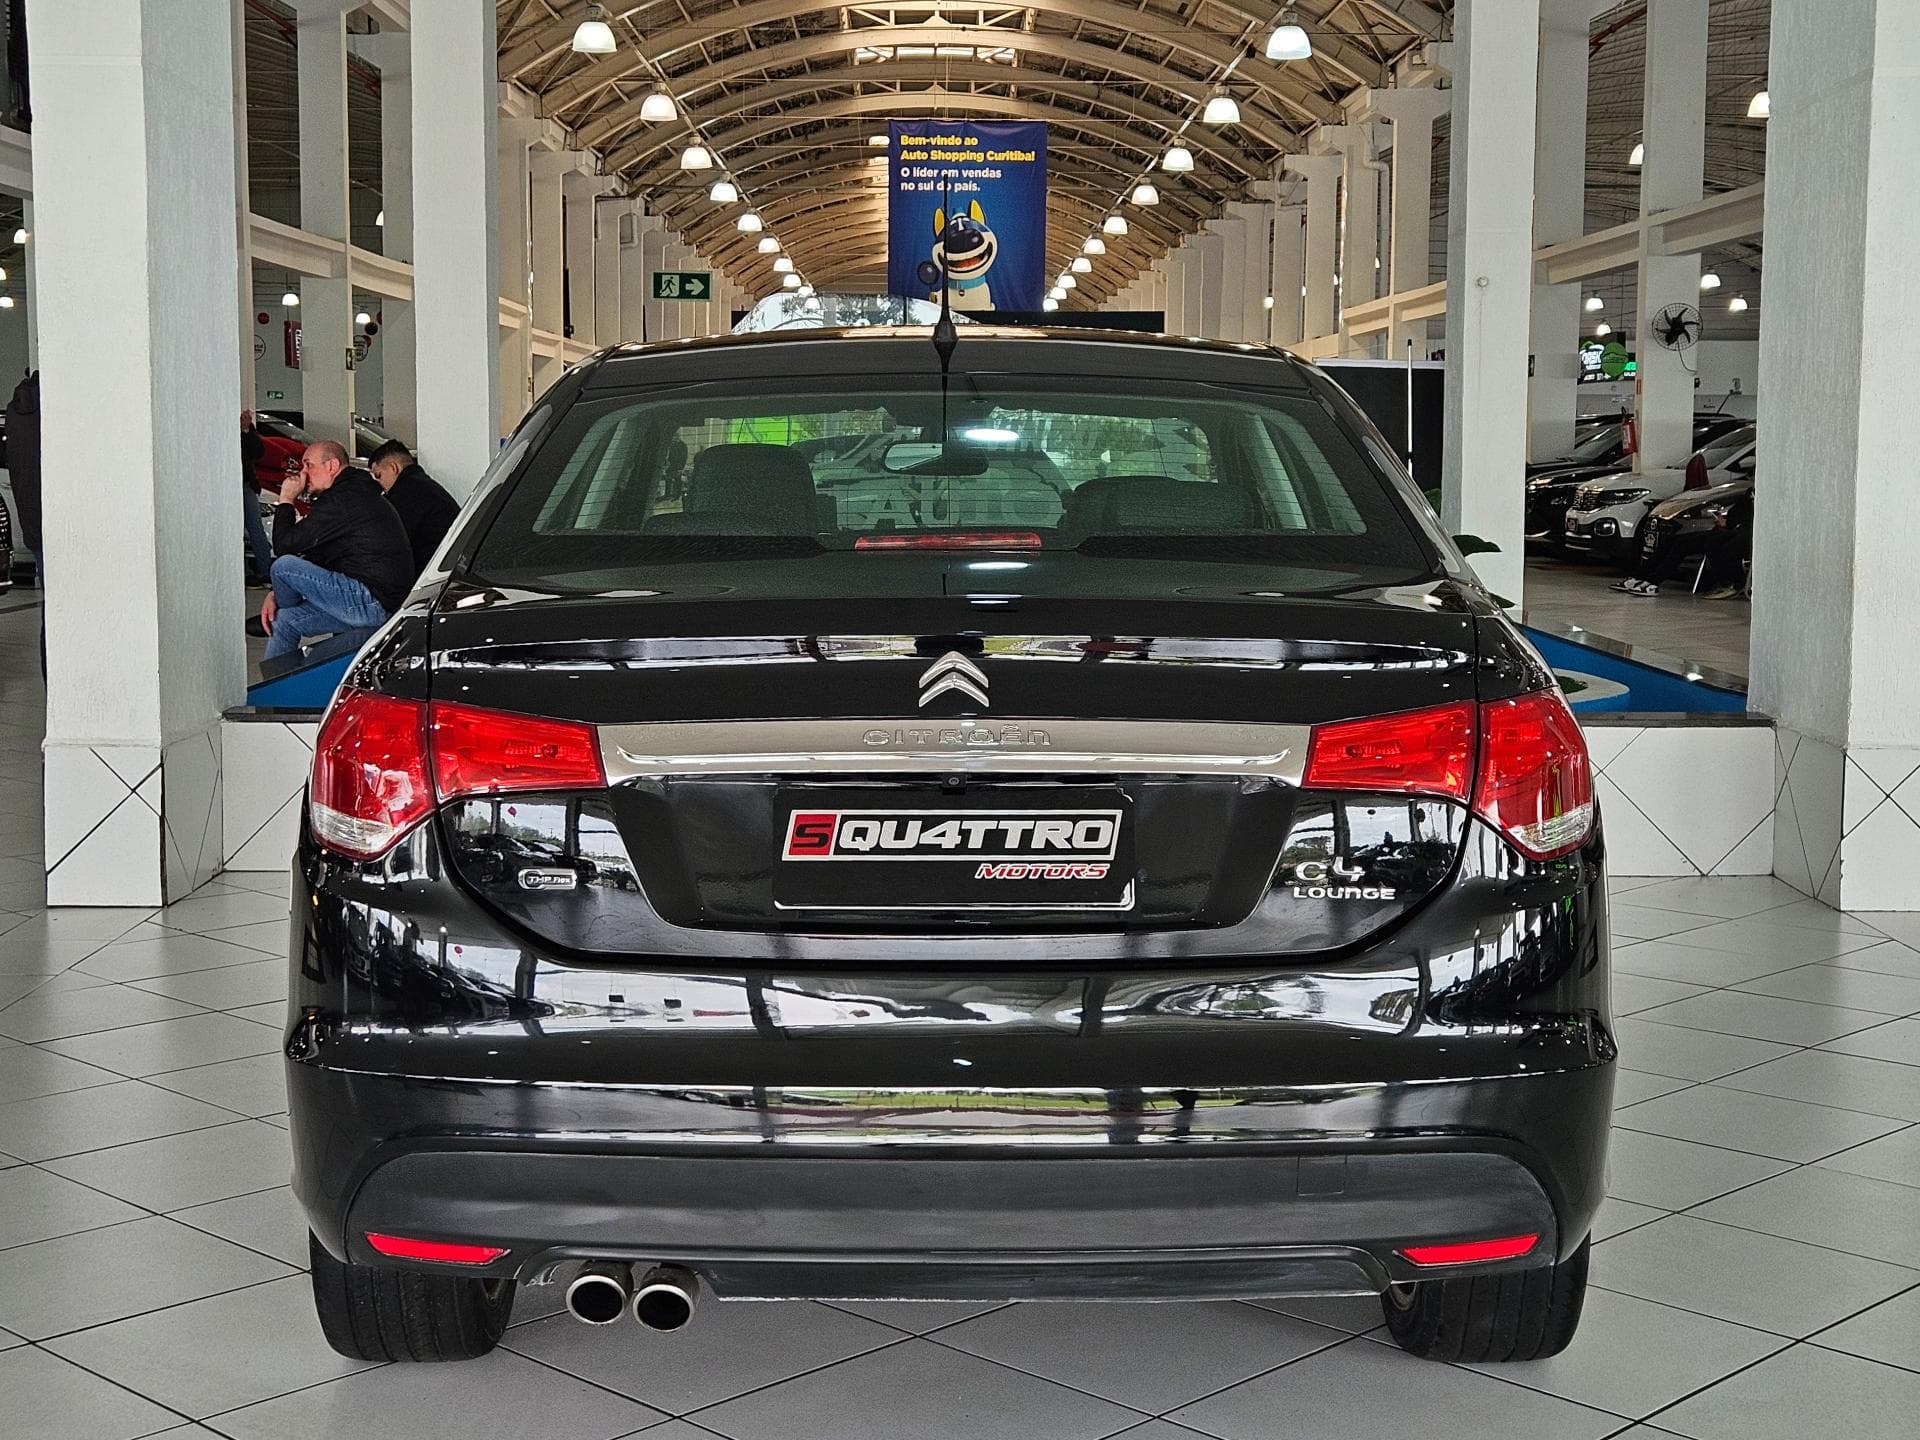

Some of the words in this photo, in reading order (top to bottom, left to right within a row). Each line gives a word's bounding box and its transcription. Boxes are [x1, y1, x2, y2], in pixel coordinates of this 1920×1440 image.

[900, 135, 962, 146] Bem-vindo
[964, 136, 979, 146] ao
[900, 150, 929, 161] Auto
[930, 150, 984, 163] Shopping
[986, 151, 1036, 162] Curitiba!
[900, 167, 910, 178] O
[912, 167, 939, 178] líder
[961, 168, 1002, 179] vendas
[900, 182, 916, 191] no
[917, 181, 934, 191] sul
[954, 181, 981, 193] país.
[974, 863, 1109, 880] MOTORS
[1295, 856, 1366, 882] C4
[1293, 886, 1396, 900] LOUNGE
